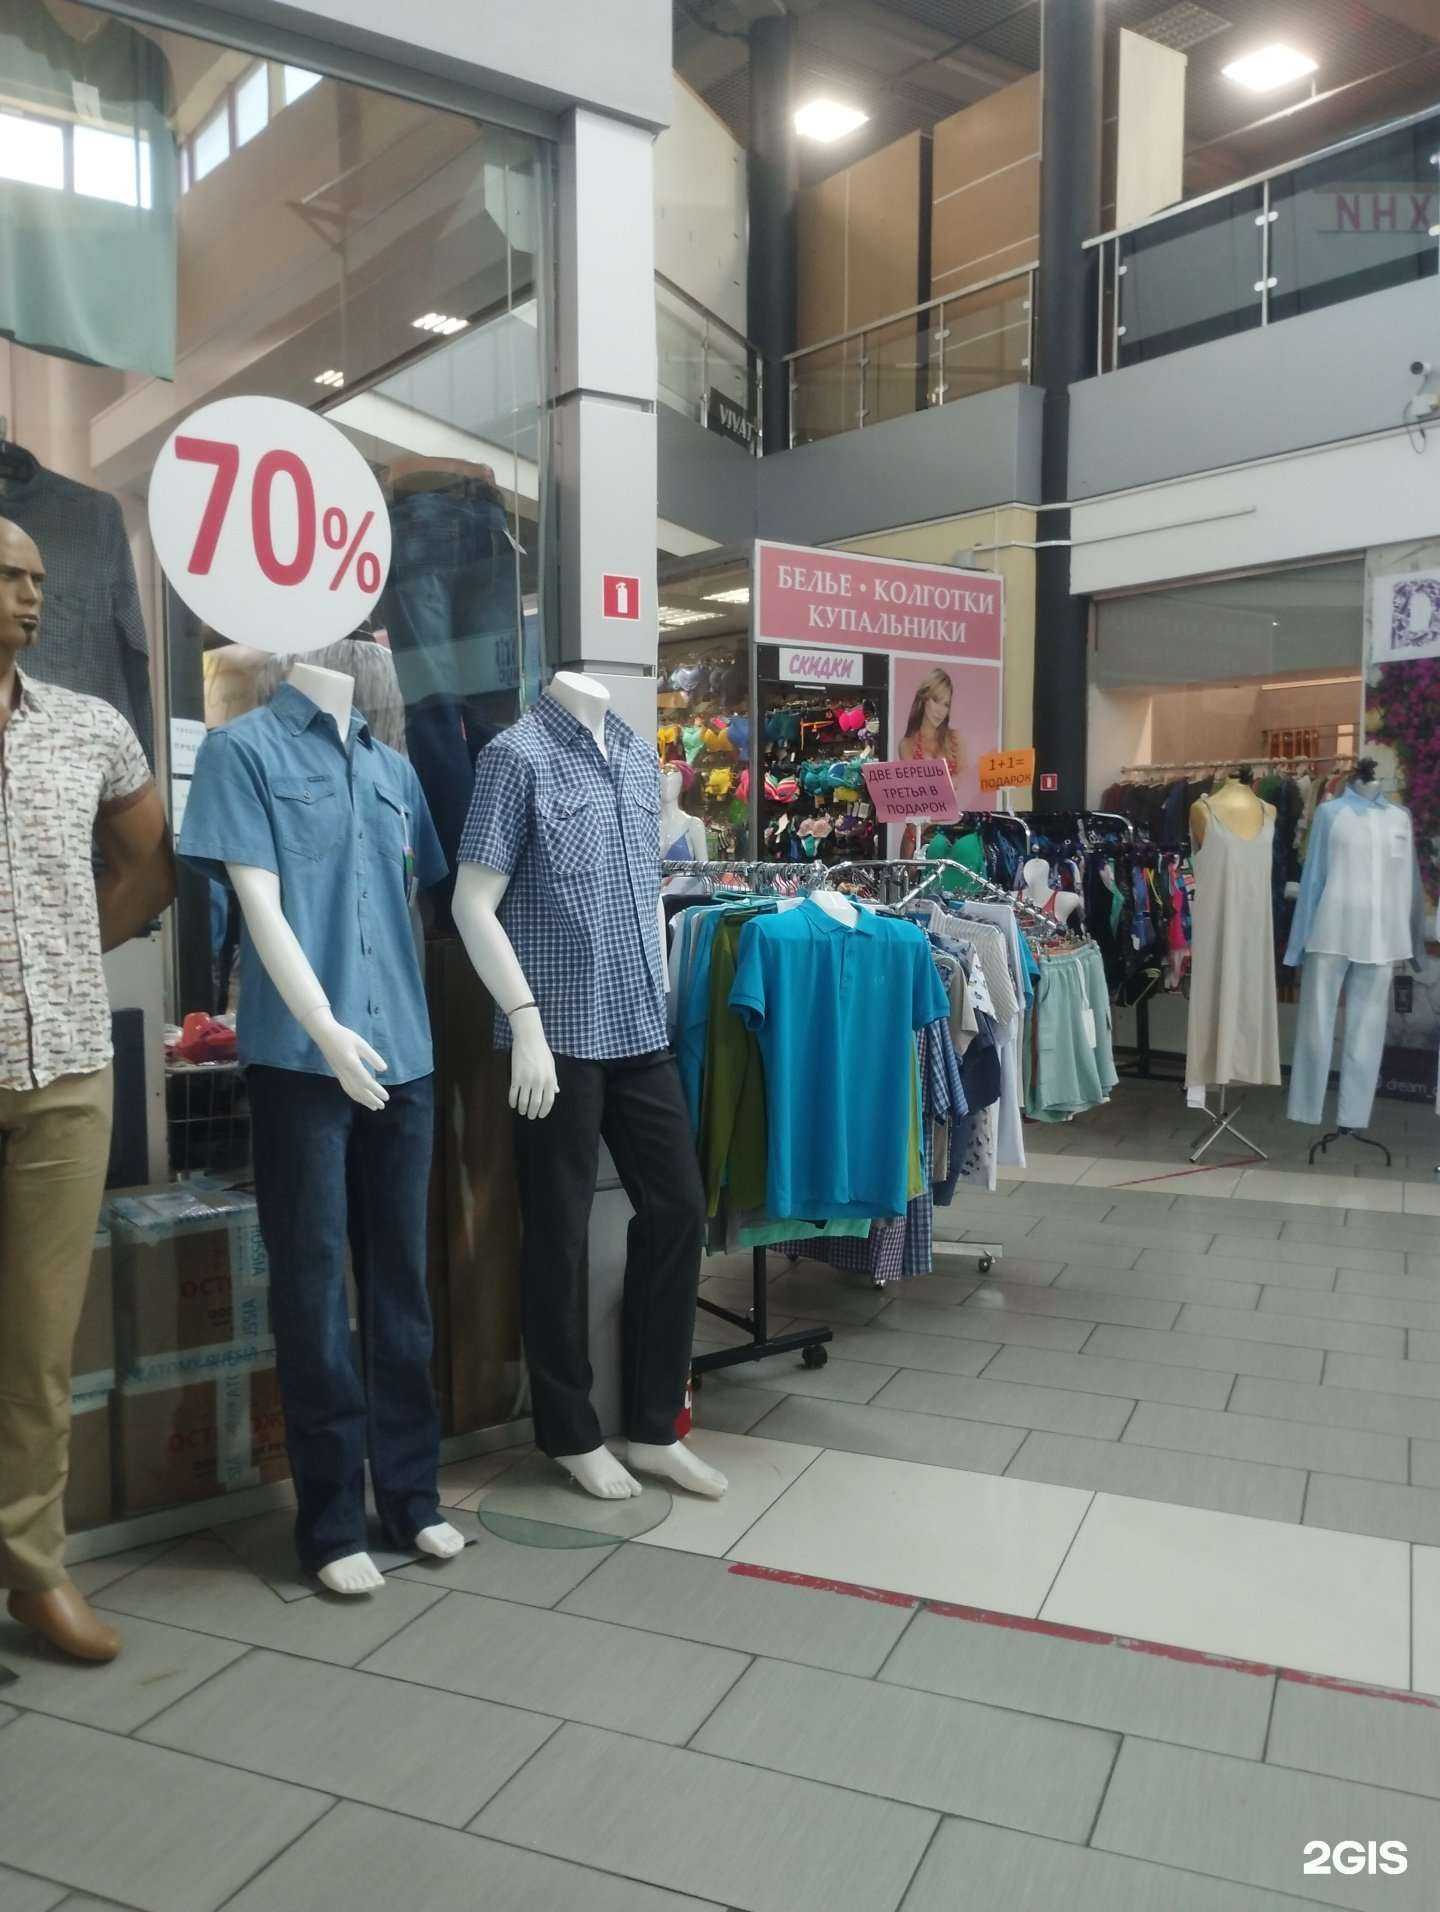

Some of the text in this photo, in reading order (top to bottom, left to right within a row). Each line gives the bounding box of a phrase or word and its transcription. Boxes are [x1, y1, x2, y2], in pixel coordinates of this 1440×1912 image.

[175, 435, 381, 594] 70%
[777, 565, 995, 615] БЕЛЬЕ КОЛГОТКИ
[808, 604, 967, 643] КУПАЛЬНИКИ
[789, 654, 854, 679] СКИДКИ
[989, 757, 1025, 771] 1+1=
[868, 765, 944, 783] ДВЕ БЕРЕШЬ
[981, 774, 1032, 790] ПОДАРОК
[883, 785, 939, 800] ТРЕТЬЯ В
[886, 801, 948, 816] ПОДАРОК
